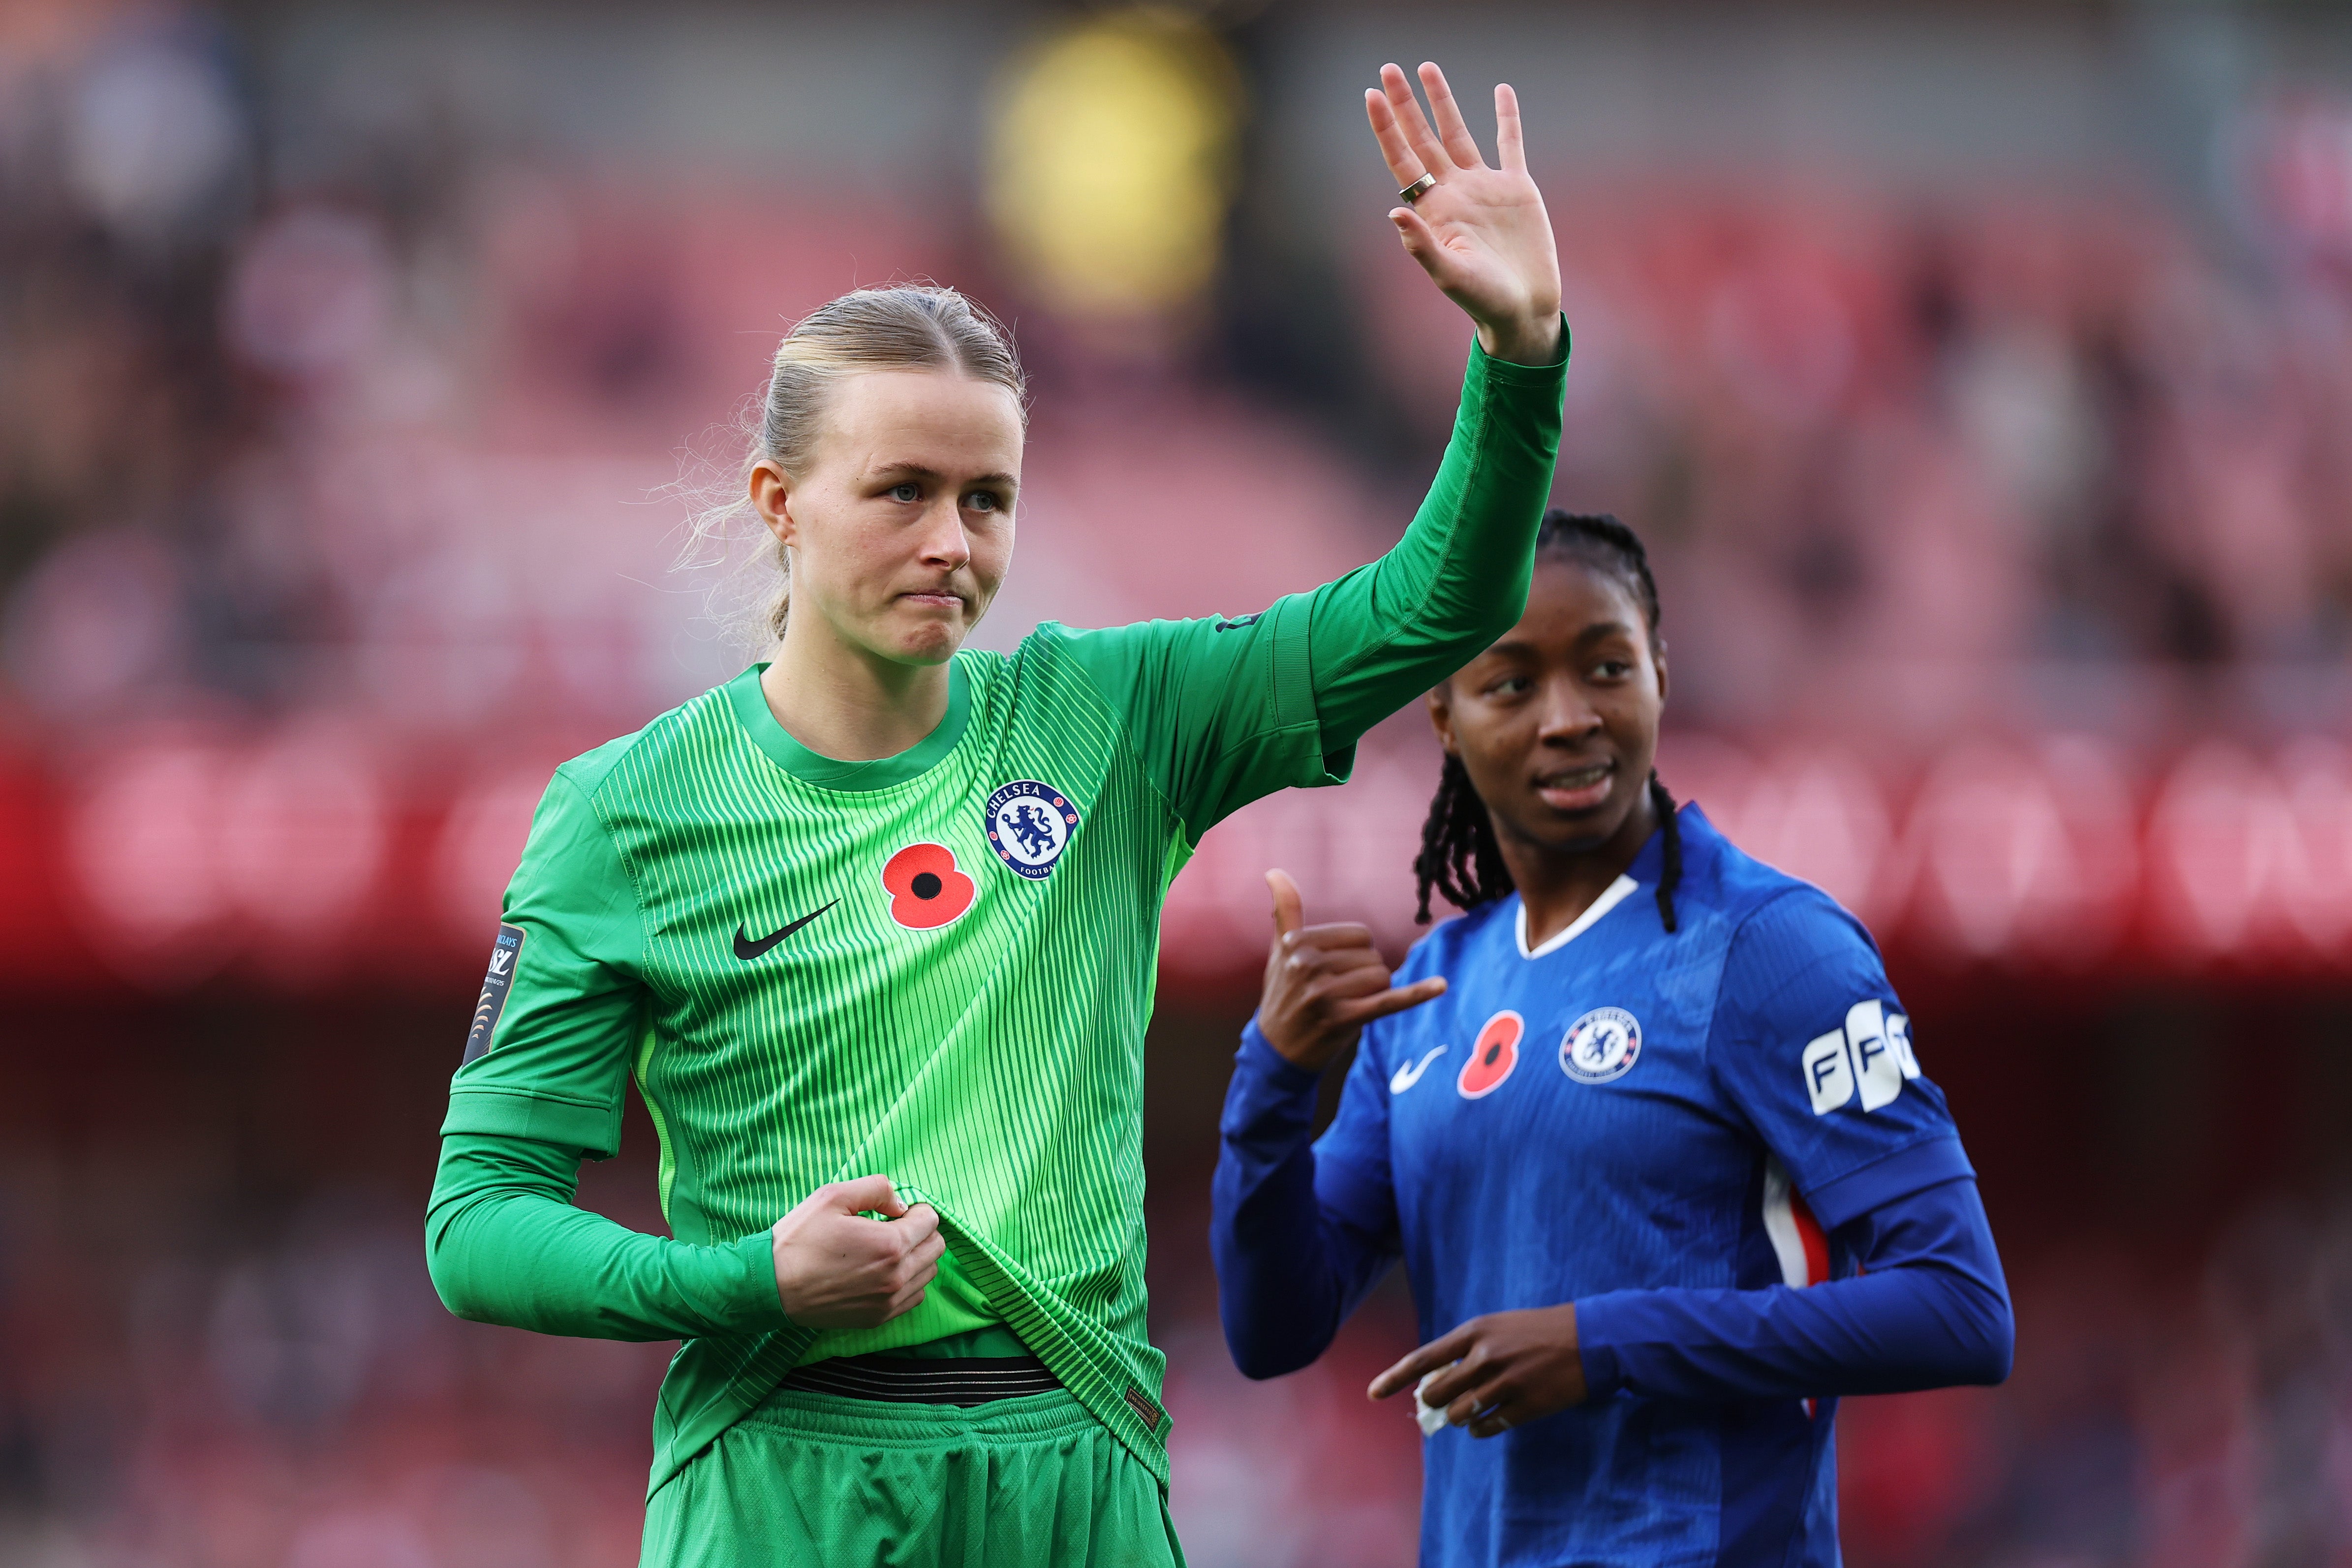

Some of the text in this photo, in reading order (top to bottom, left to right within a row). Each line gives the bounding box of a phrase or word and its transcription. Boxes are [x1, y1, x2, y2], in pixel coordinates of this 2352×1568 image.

[987, 783, 1040, 818] CHELSEA
[496, 934, 518, 948] RCLAYS
[488, 948, 513, 976] SL
